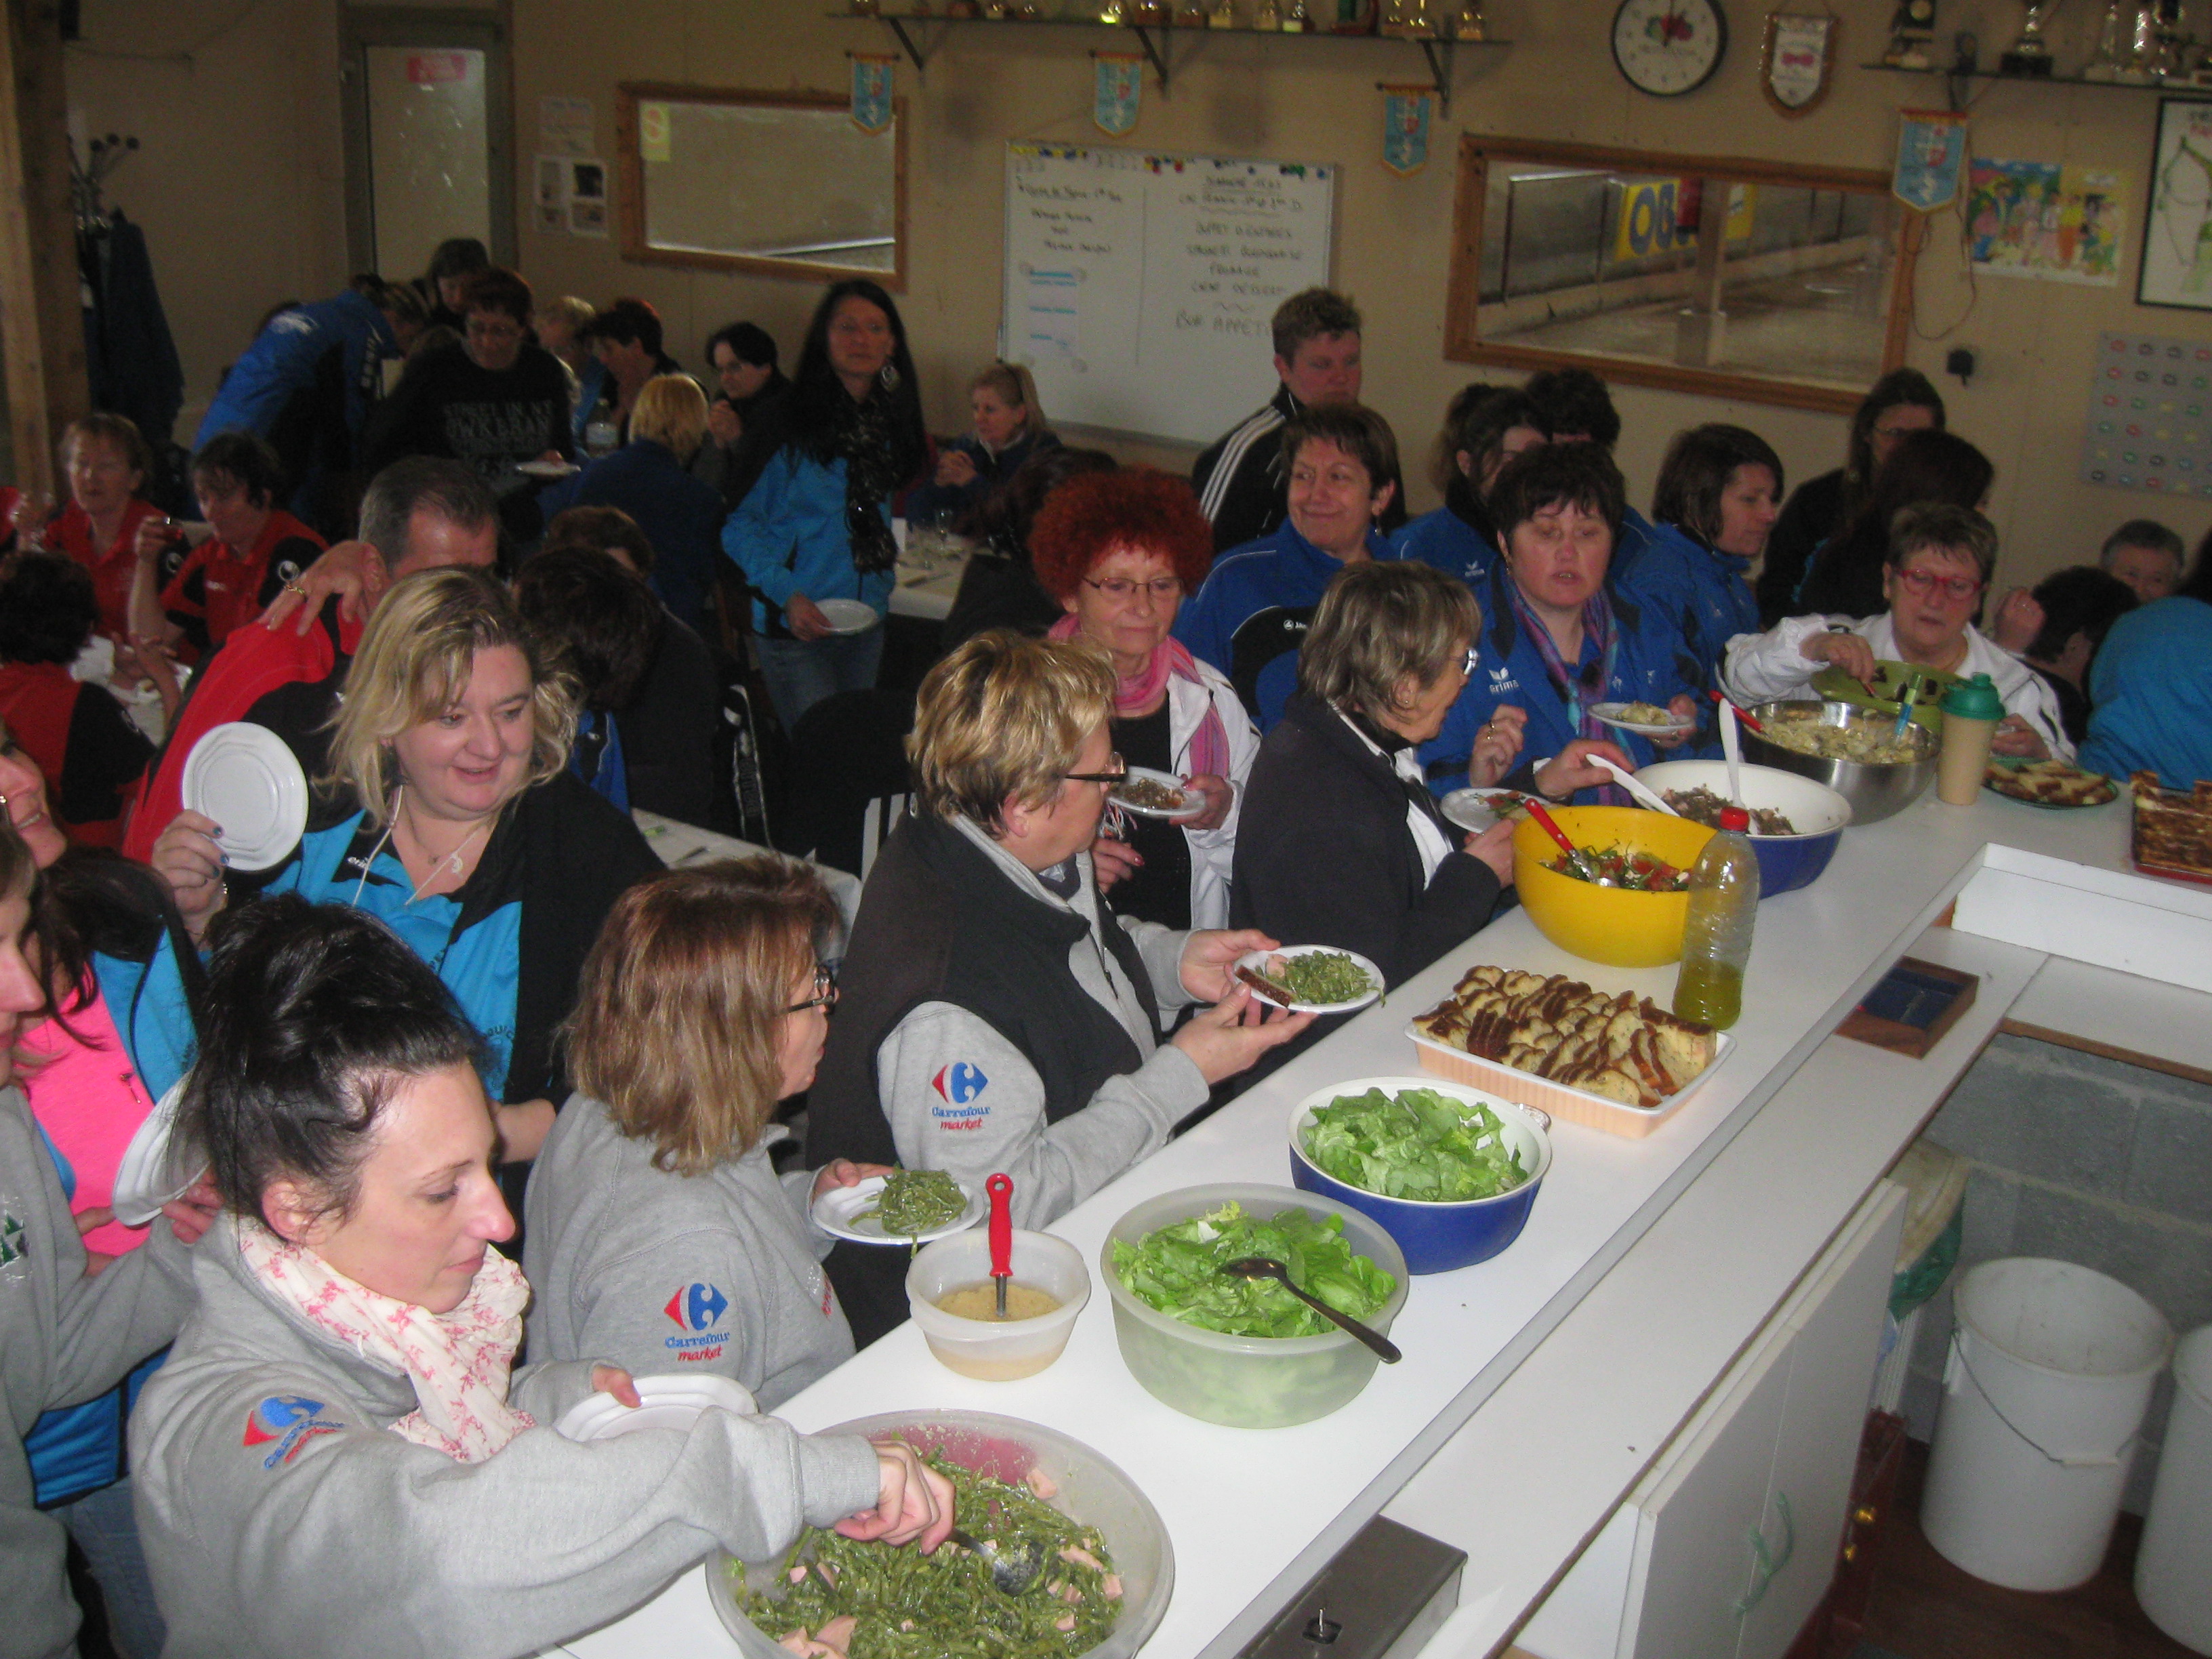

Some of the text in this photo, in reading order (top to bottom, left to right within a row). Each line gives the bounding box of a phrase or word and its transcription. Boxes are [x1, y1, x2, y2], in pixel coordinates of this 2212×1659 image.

[1489, 680, 1519, 695] erima
[932, 1106, 990, 1118] Carrefour
[940, 1116, 983, 1130] market
[665, 1332, 730, 1349] Carrefour
[678, 1344, 723, 1361] market
